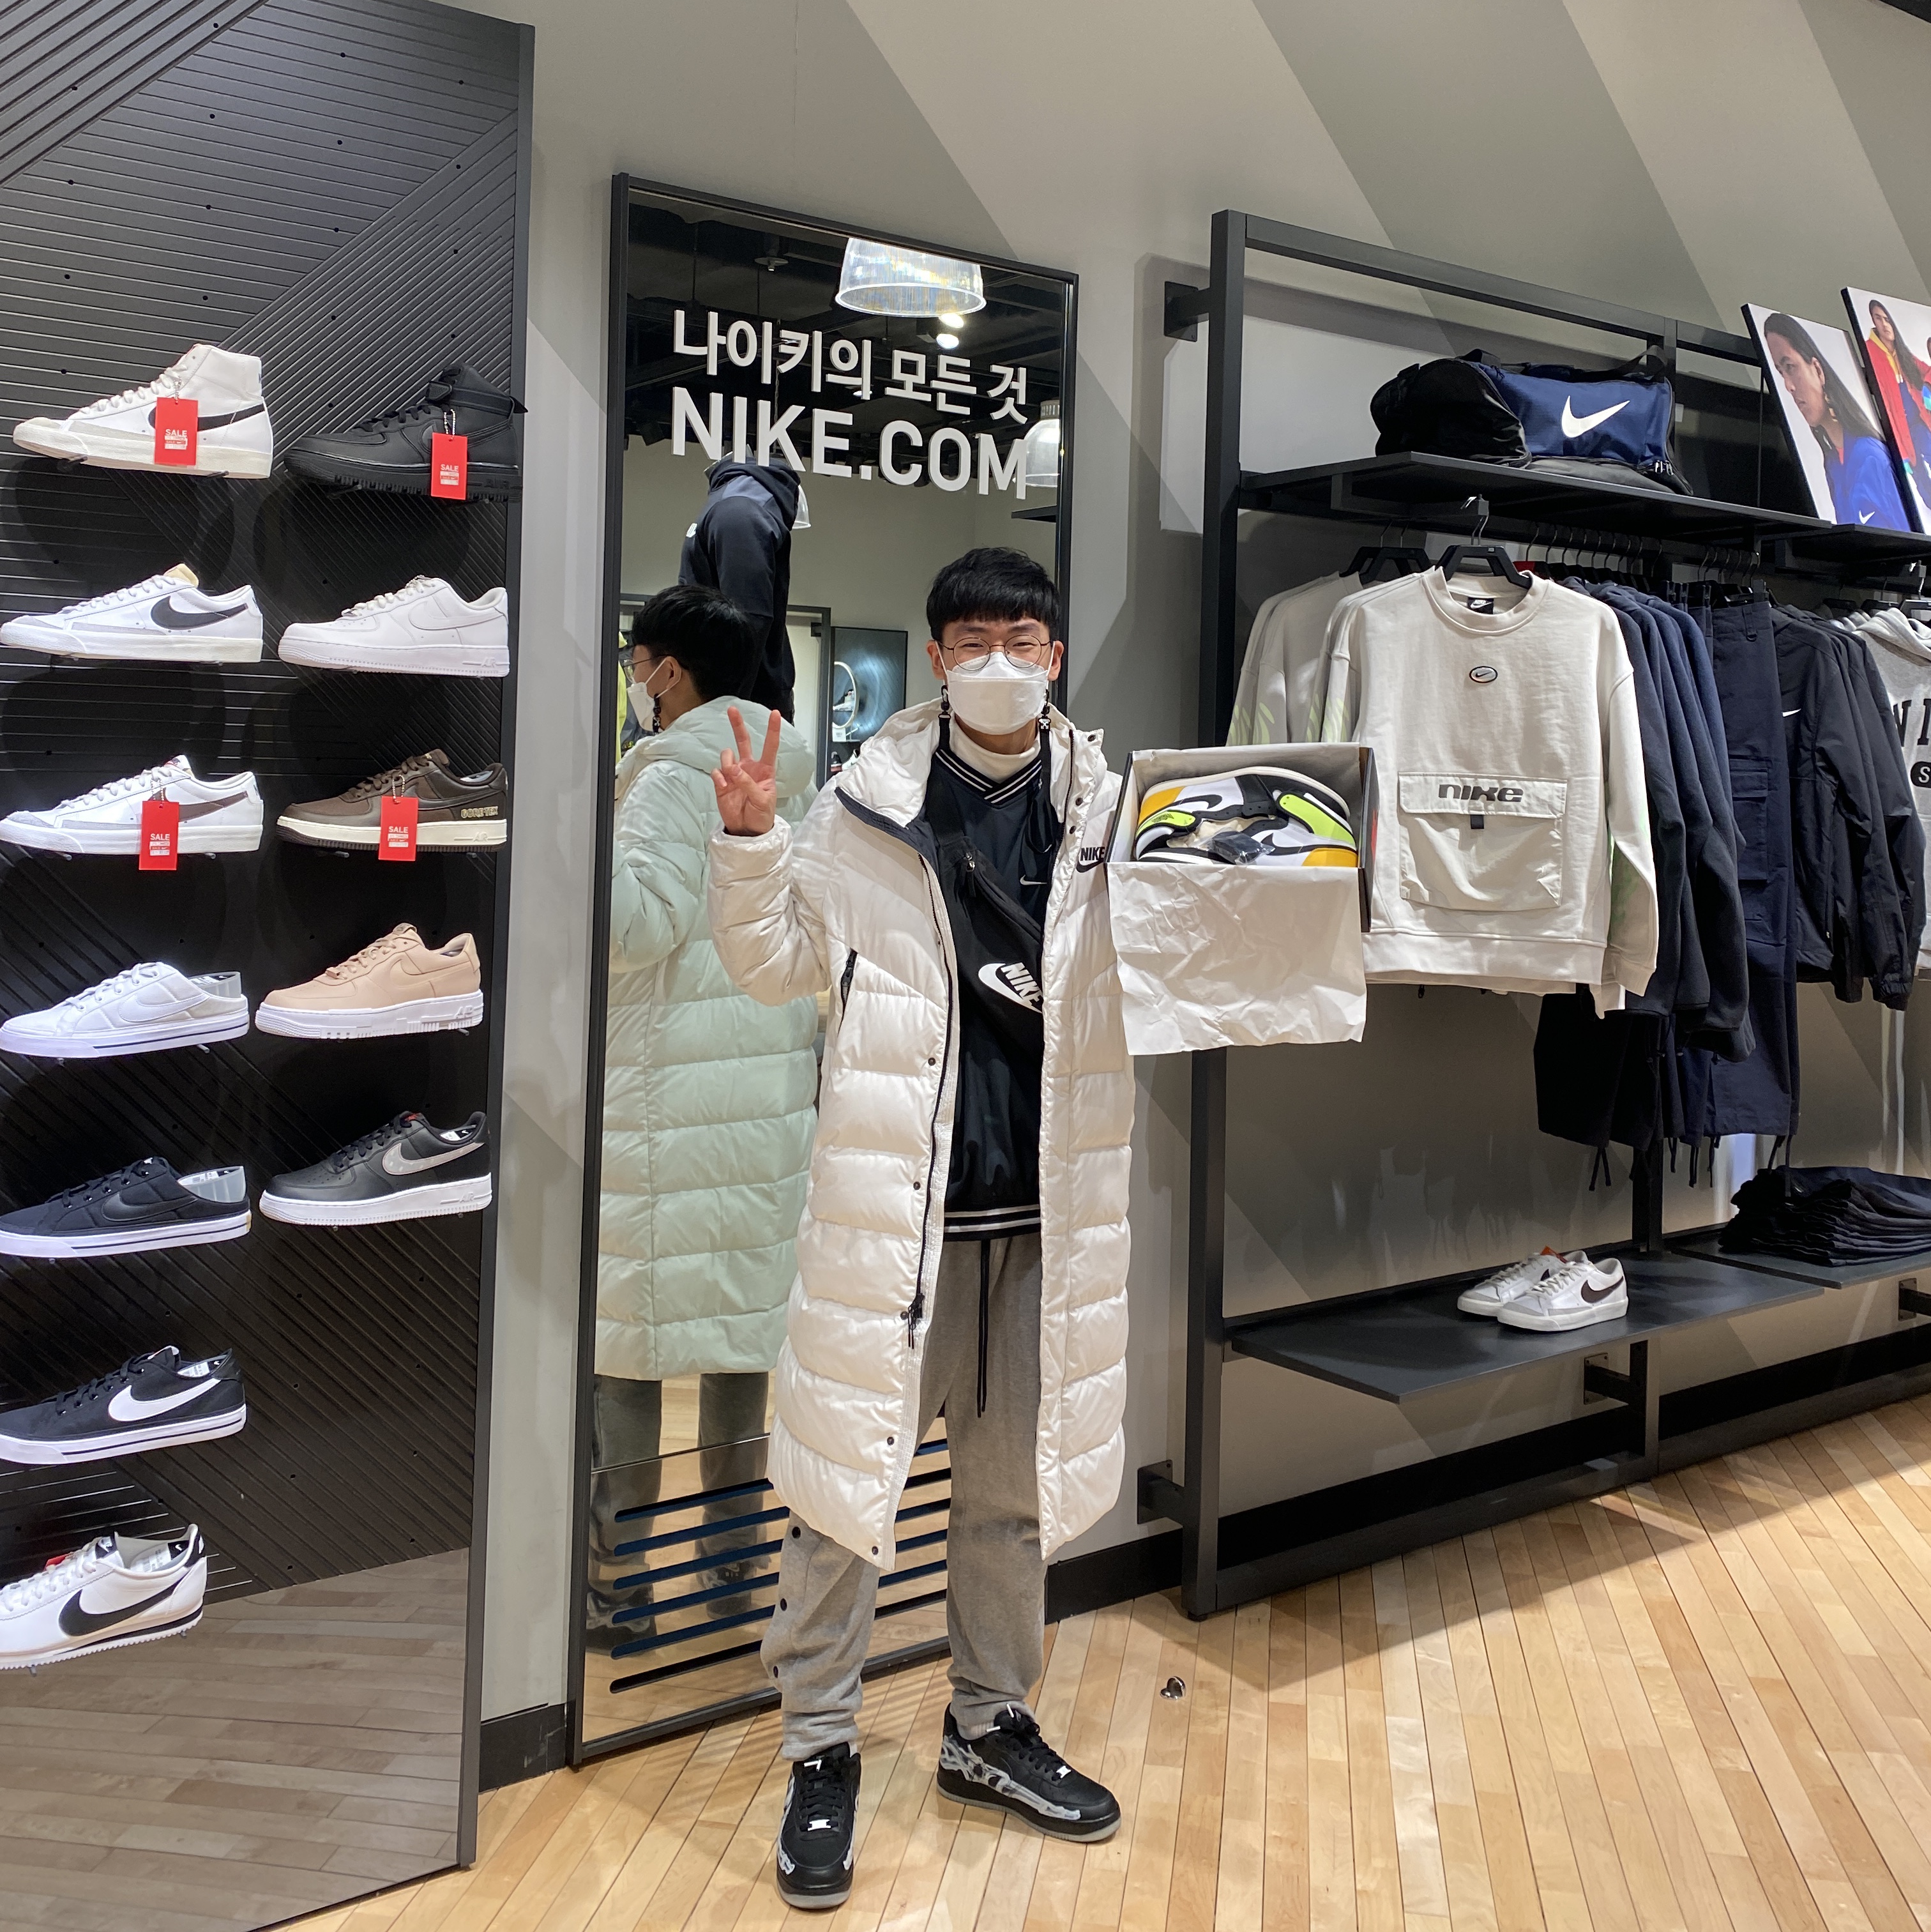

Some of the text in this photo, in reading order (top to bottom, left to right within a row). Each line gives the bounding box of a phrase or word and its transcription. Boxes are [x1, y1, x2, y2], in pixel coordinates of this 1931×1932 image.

[674, 310, 1028, 424] 나이키의 모든 것
[165, 429, 188, 437] SALE
[672, 386, 1027, 500] NIKE.COM
[440, 464, 459, 473] SALE
[460, 805, 499, 819] GORE-TEX
[1080, 846, 1105, 861] NIKE
[1000, 962, 1043, 1006] NIKE
